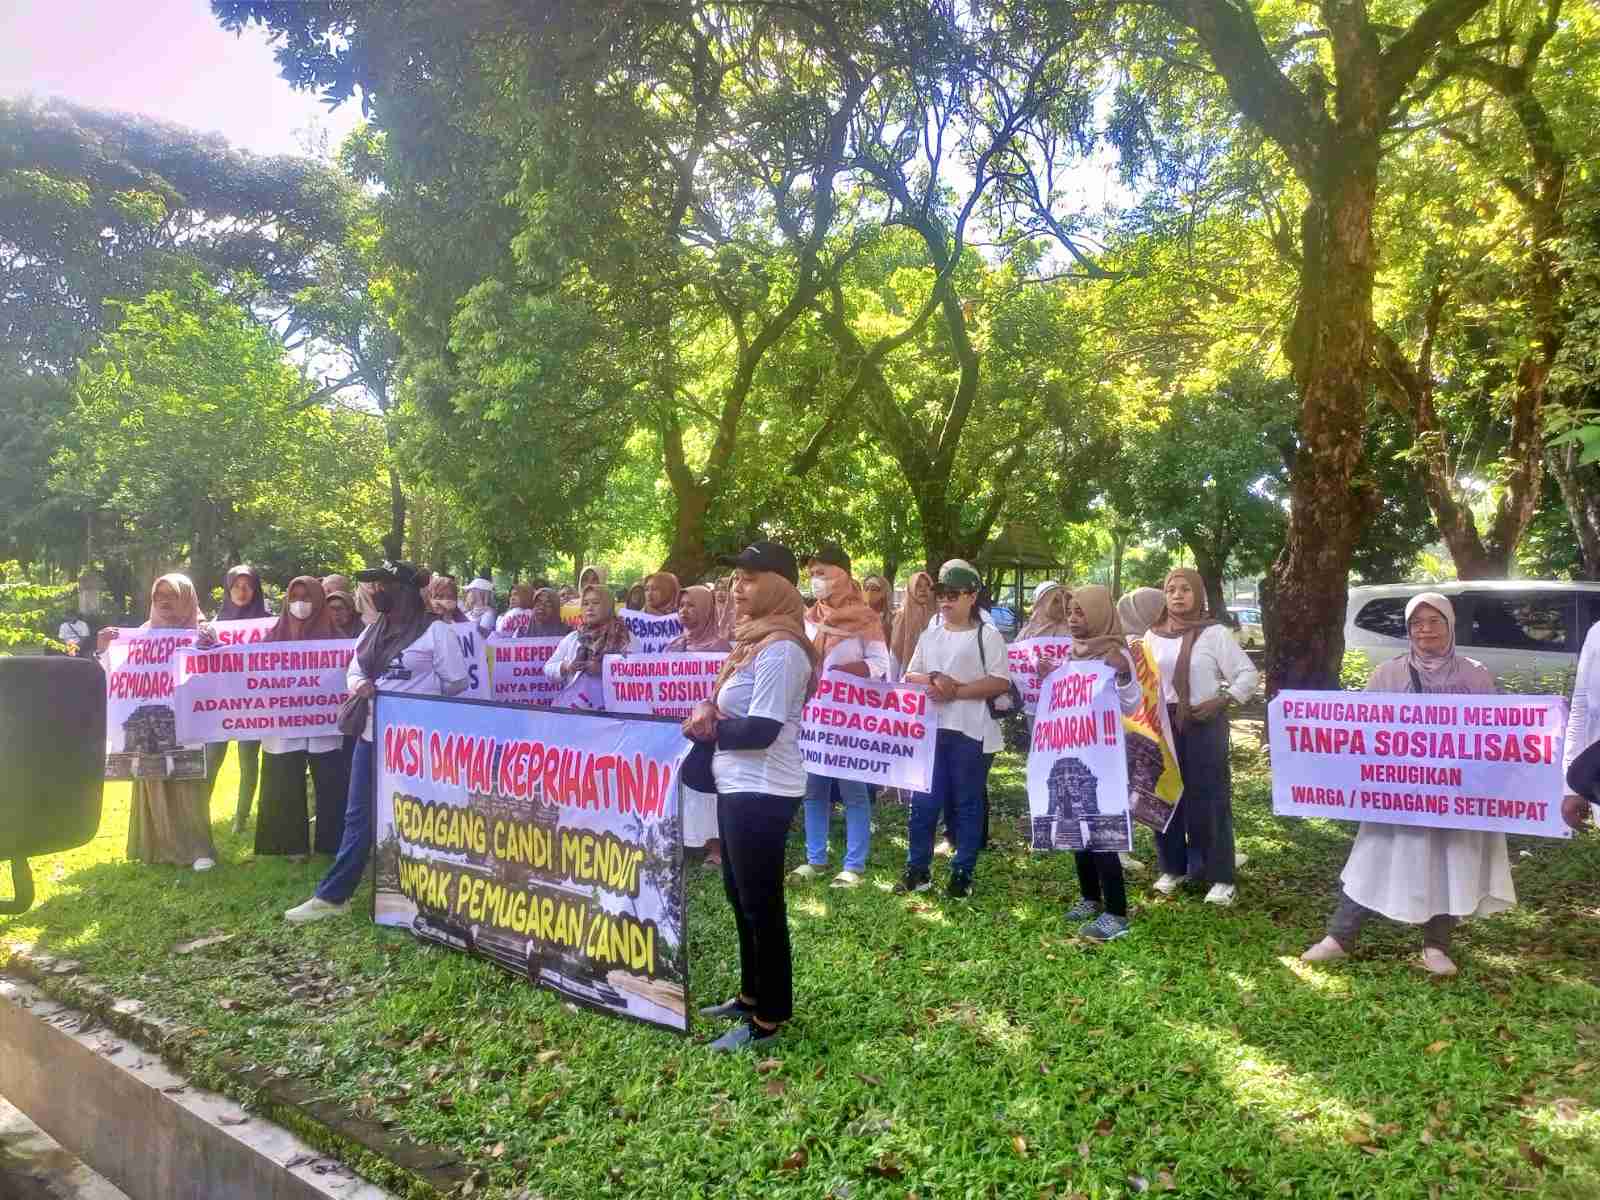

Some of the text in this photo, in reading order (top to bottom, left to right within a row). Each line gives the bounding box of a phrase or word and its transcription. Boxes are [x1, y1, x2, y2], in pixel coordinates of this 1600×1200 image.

[186, 652, 243, 673] ADUAN
[672, 661, 702, 675] CANDI
[247, 675, 320, 689] DAMPAK
[612, 682, 654, 702] TANPA
[193, 699, 265, 712] ADANYA
[1283, 700, 1548, 727] PEMUGARAN CANDI MENDUT
[222, 716, 275, 729] CANDI
[812, 706, 925, 740] PEDAGANG
[818, 731, 913, 758] PEMUGARAN
[1285, 725, 1552, 764] TANPA SOSIALISASI
[430, 732, 495, 792] DAMAI
[824, 753, 891, 774] MENDUT
[1360, 764, 1462, 787] MERUGIKAN
[1291, 785, 1549, 822] WARGA / PEDAGANG SETEMPAT
[394, 798, 644, 891] PEDAGANG CANDI MENDUT
[456, 874, 585, 948] PEMUGARAN
[586, 913, 654, 974] CANDI
